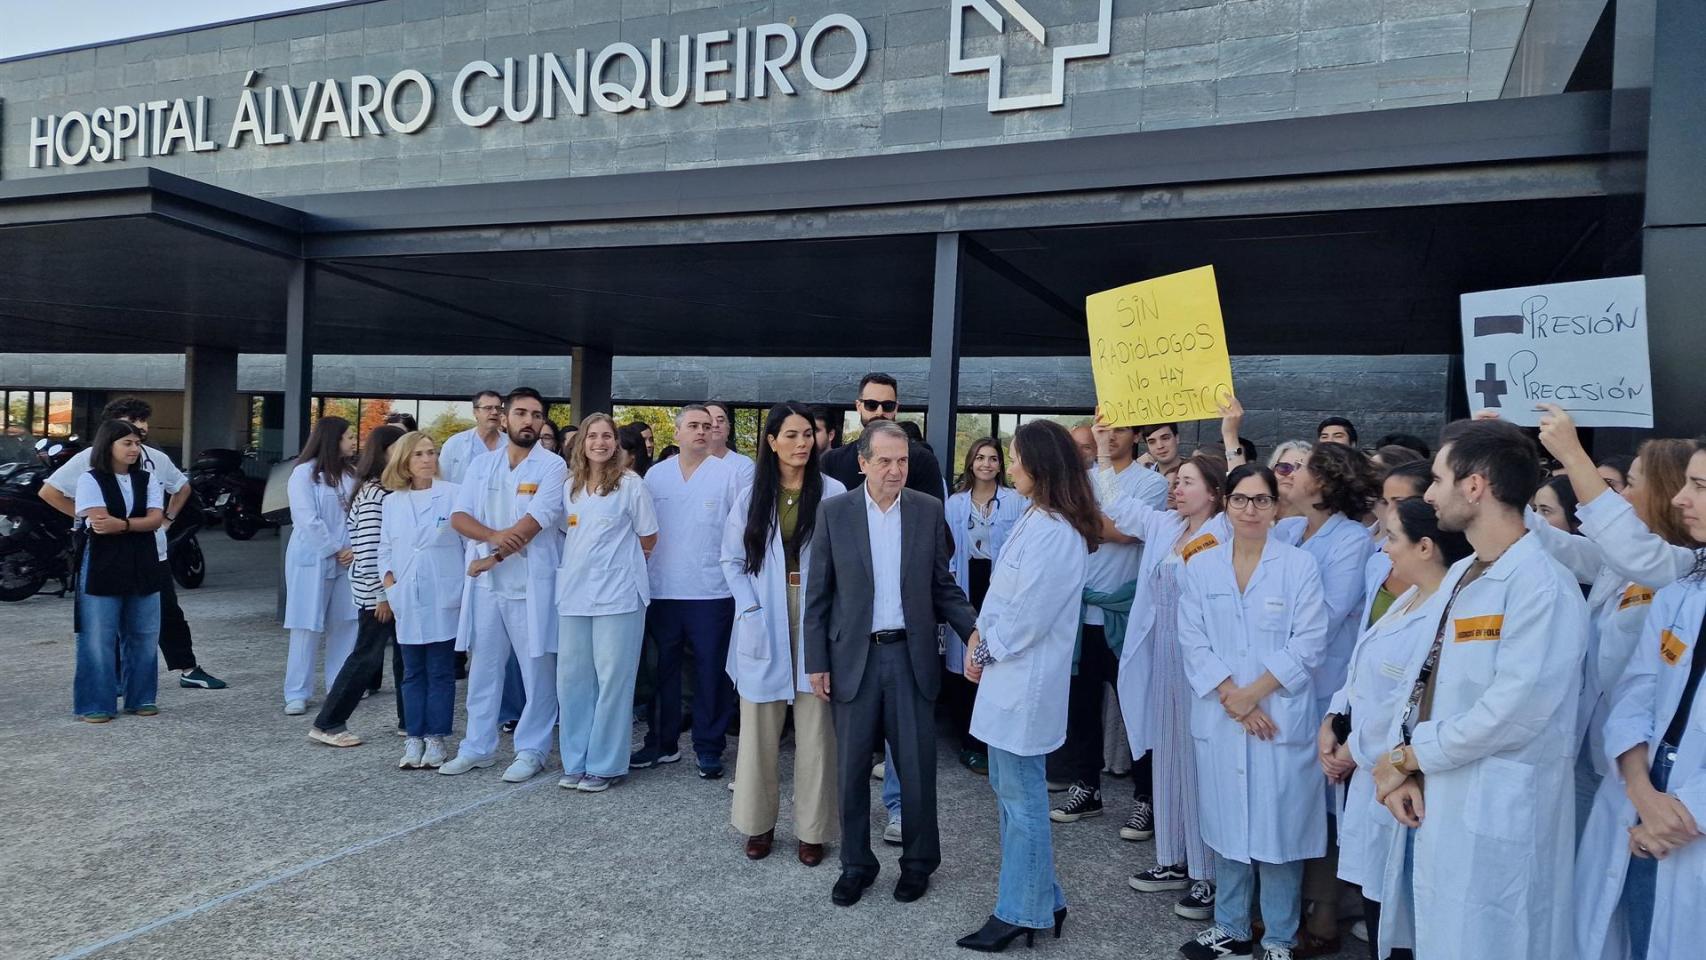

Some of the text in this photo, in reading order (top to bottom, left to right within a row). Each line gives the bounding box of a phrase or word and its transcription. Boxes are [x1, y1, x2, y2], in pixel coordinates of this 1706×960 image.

[29, 13, 868, 168] HOSPITAL ÁLVARO CUNQUEIRO
[1521, 294, 1639, 339] PRESIÓN
[1159, 365, 1184, 387] HAY
